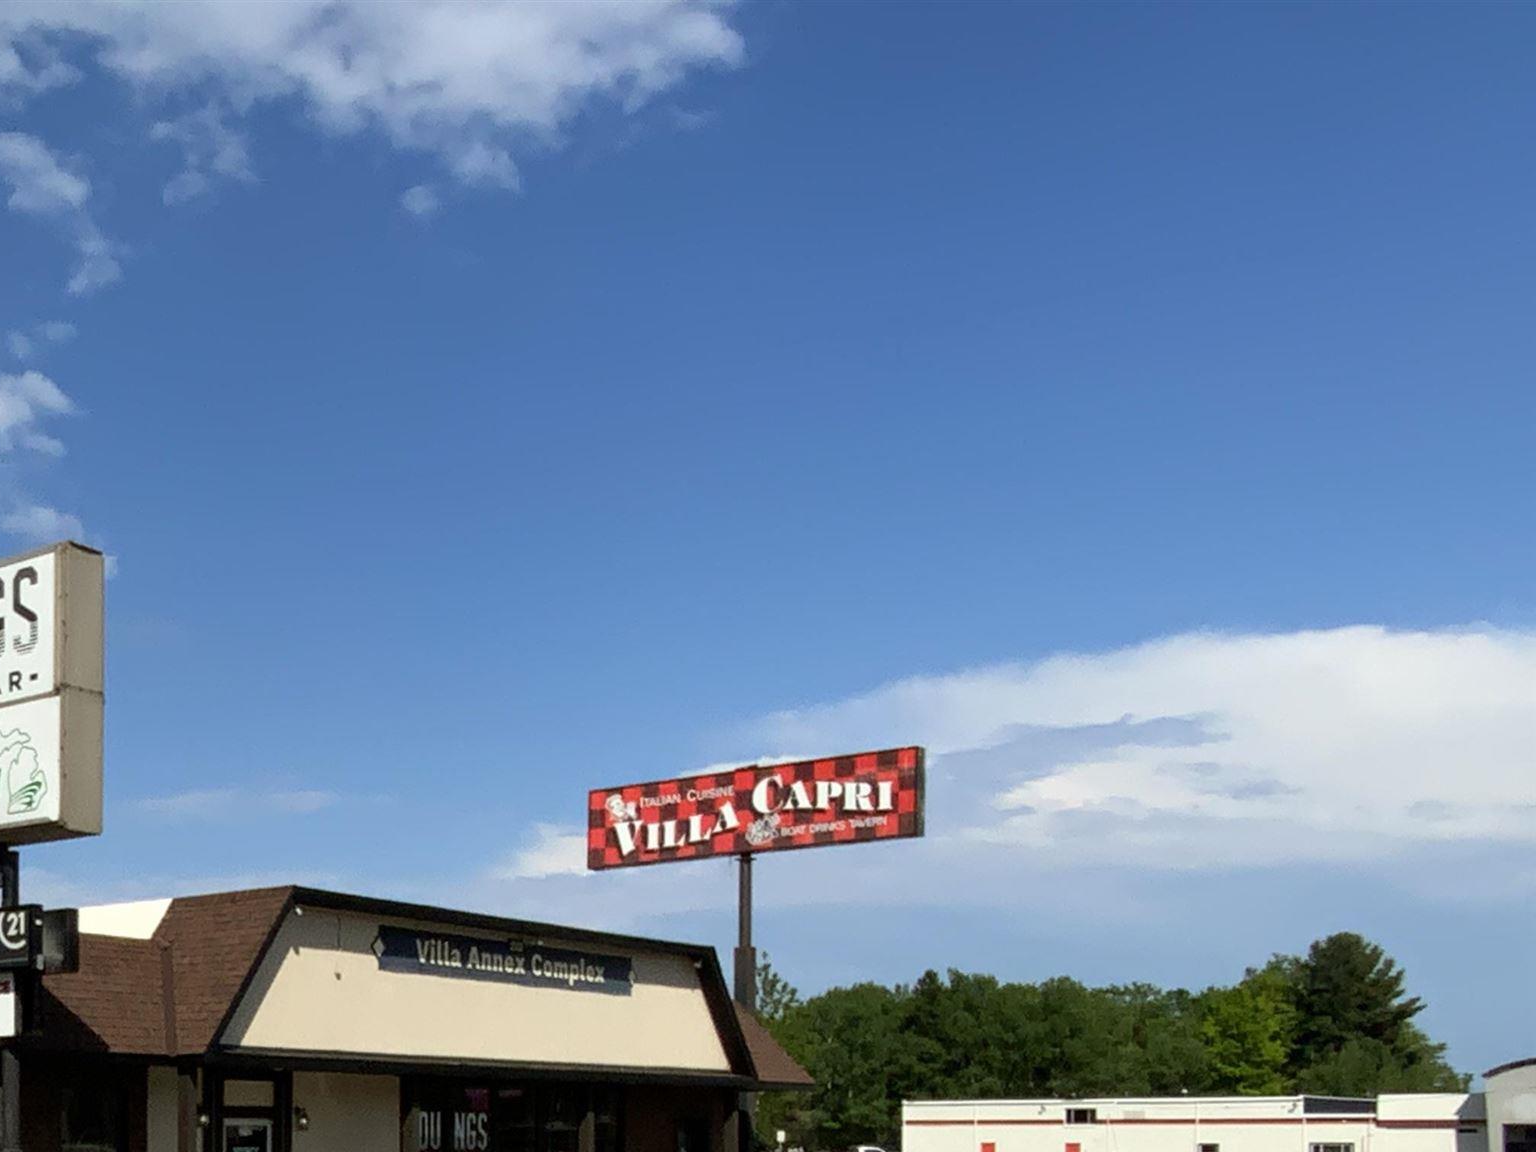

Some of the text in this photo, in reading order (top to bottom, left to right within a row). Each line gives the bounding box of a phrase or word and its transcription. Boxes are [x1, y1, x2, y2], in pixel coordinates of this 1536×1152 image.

[613, 773, 894, 856] VILLA CAPRI
[415, 938, 605, 986] Villa Annex Complex
